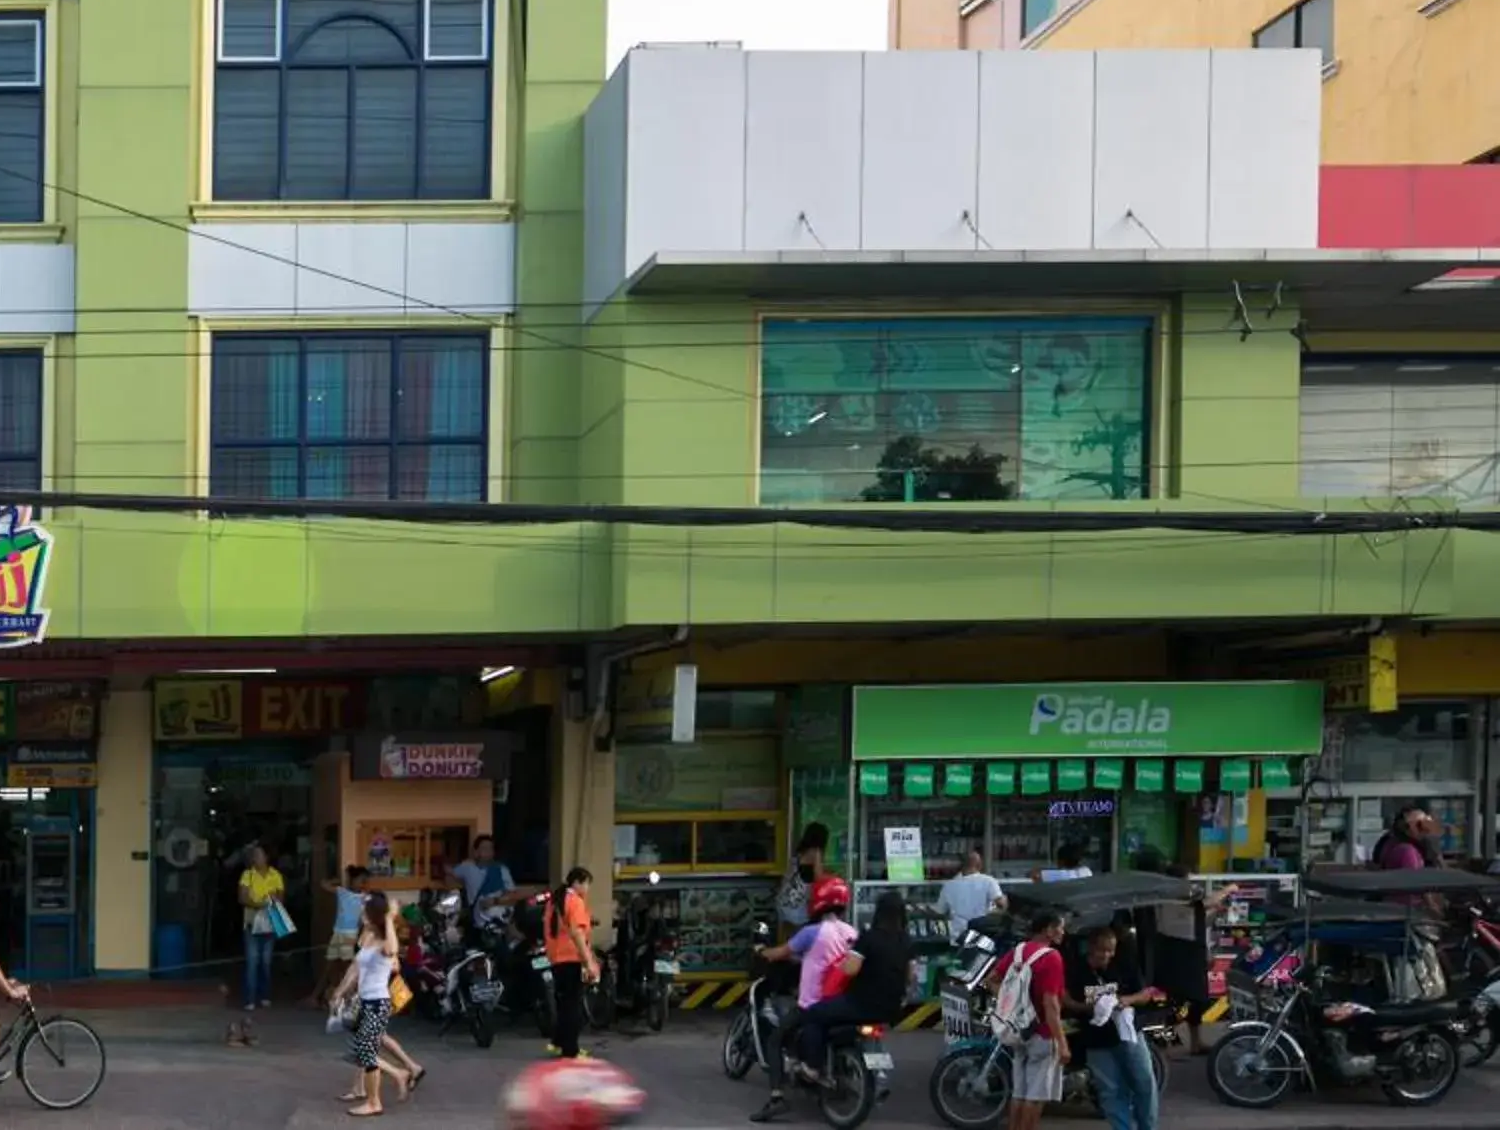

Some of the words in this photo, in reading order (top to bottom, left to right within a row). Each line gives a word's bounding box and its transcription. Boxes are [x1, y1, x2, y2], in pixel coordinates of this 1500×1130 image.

[260, 685, 350, 731] EXIT
[1029, 693, 1171, 736] Padala
[408, 761, 480, 775] DONUTS
